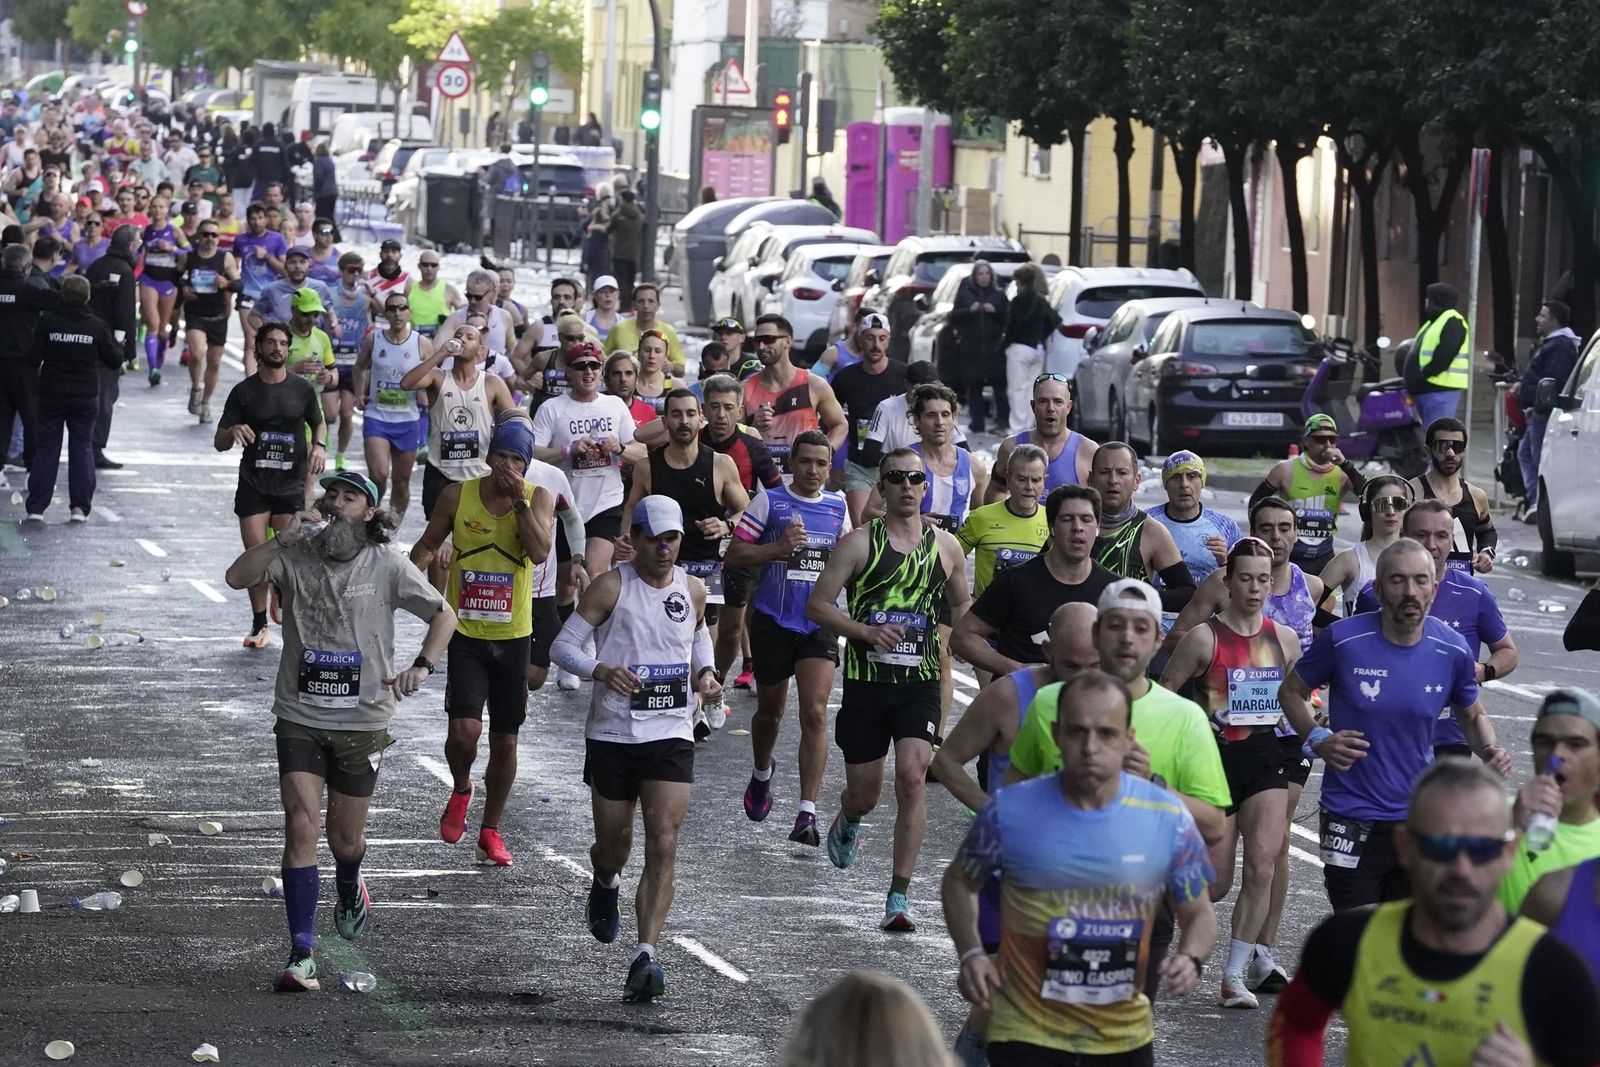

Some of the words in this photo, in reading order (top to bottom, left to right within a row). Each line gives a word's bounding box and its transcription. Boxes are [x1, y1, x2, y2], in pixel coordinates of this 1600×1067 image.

[443, 74, 464, 88] 30
[49, 332, 94, 345] VOLUNTEER
[1231, 413, 1258, 425] 4249
[569, 416, 613, 436] GEORGE
[270, 432, 295, 443] ZURICH
[453, 432, 475, 440] ZURICH
[266, 451, 285, 462] FEDE
[448, 450, 471, 460] DIOGO
[1306, 510, 1331, 518] ZURICH
[807, 536, 833, 546] ZURICH
[807, 550, 822, 558] 5182
[1446, 562, 1466, 571] URICH
[478, 573, 508, 583] ZURICH
[478, 588, 494, 598] 1406
[464, 597, 508, 610] ANTONIO
[319, 653, 356, 665] ZURICH
[319, 671, 339, 680] 3935
[653, 667, 684, 678] ZURICH
[1249, 669, 1280, 679] ZURICH
[1353, 667, 1389, 679] FRANCE
[307, 680, 351, 695] SERGIO
[654, 684, 671, 694] 4721
[1251, 687, 1269, 697] 7928
[648, 696, 675, 709] REFO
[1082, 922, 1135, 939] ZURICH
